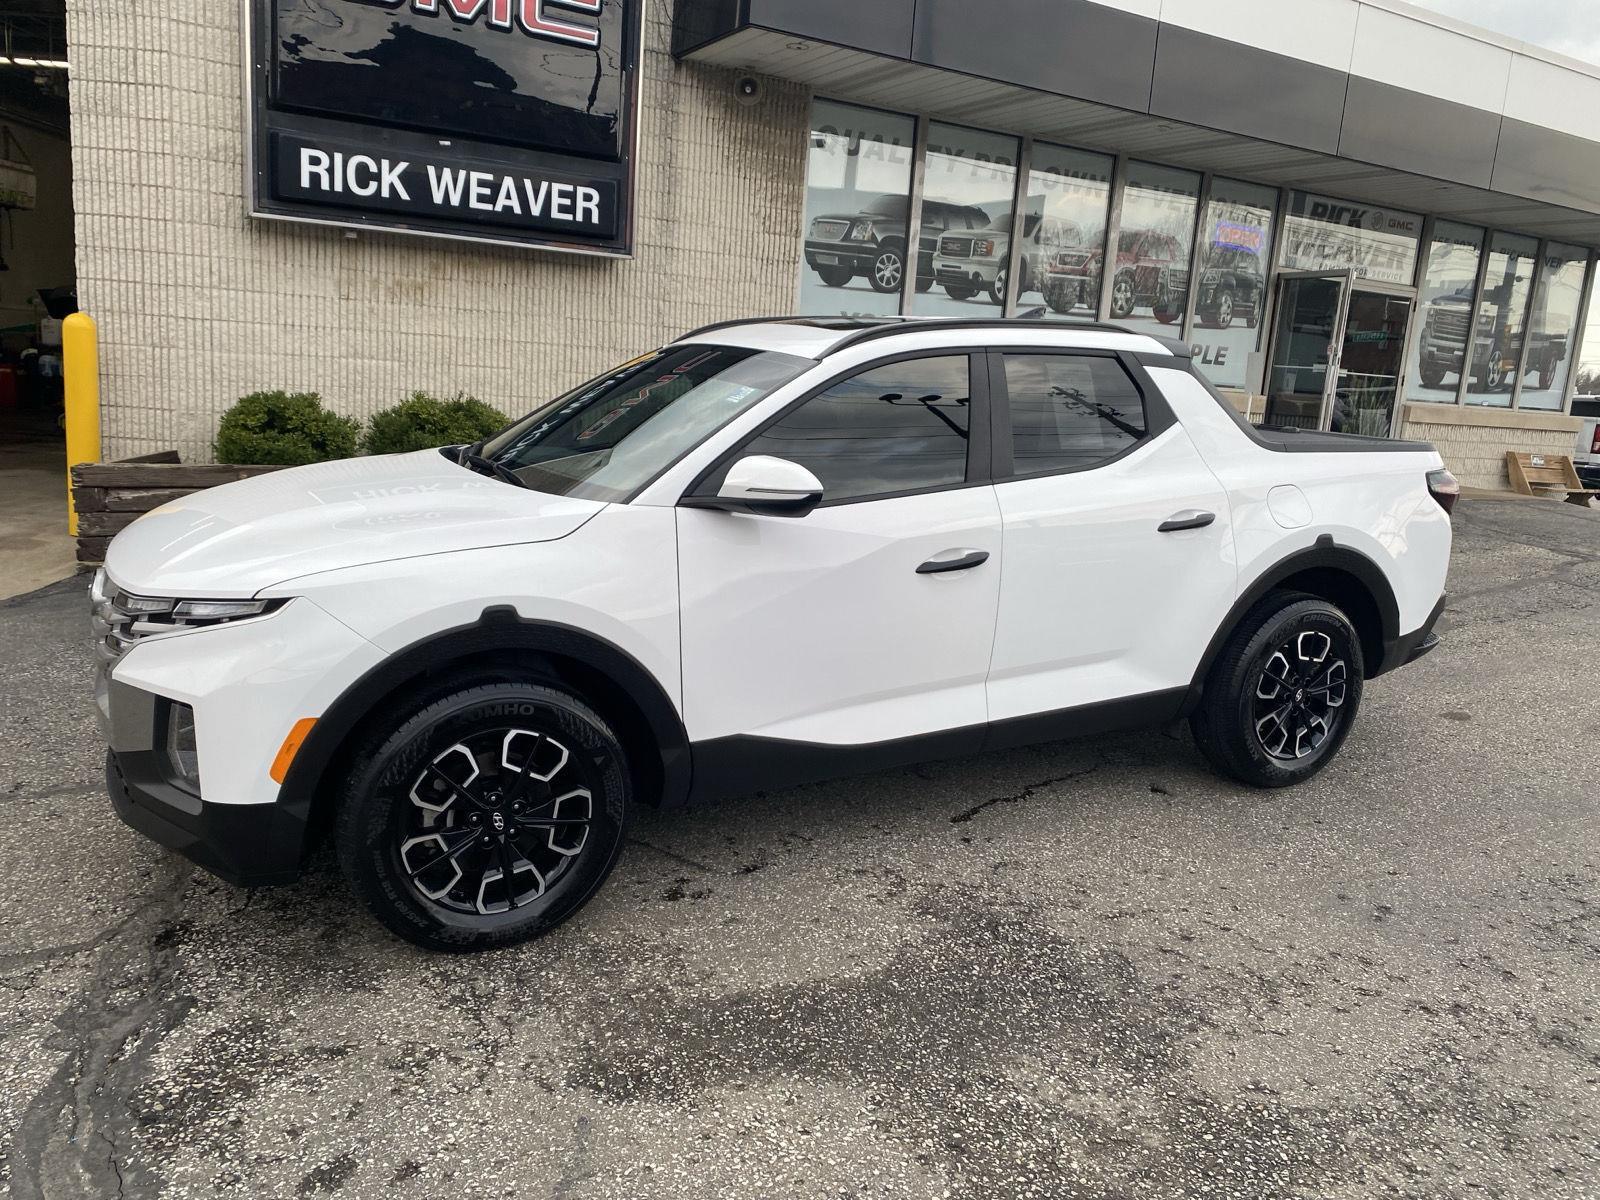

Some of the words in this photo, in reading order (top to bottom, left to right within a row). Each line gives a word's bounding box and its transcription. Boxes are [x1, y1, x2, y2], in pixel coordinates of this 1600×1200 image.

[300, 147, 411, 201] RICK
[427, 165, 601, 225] WEAVER
[1387, 219, 1414, 231] GMC
[1218, 226, 1260, 249] OPEN
[463, 703, 536, 721] UMHO
